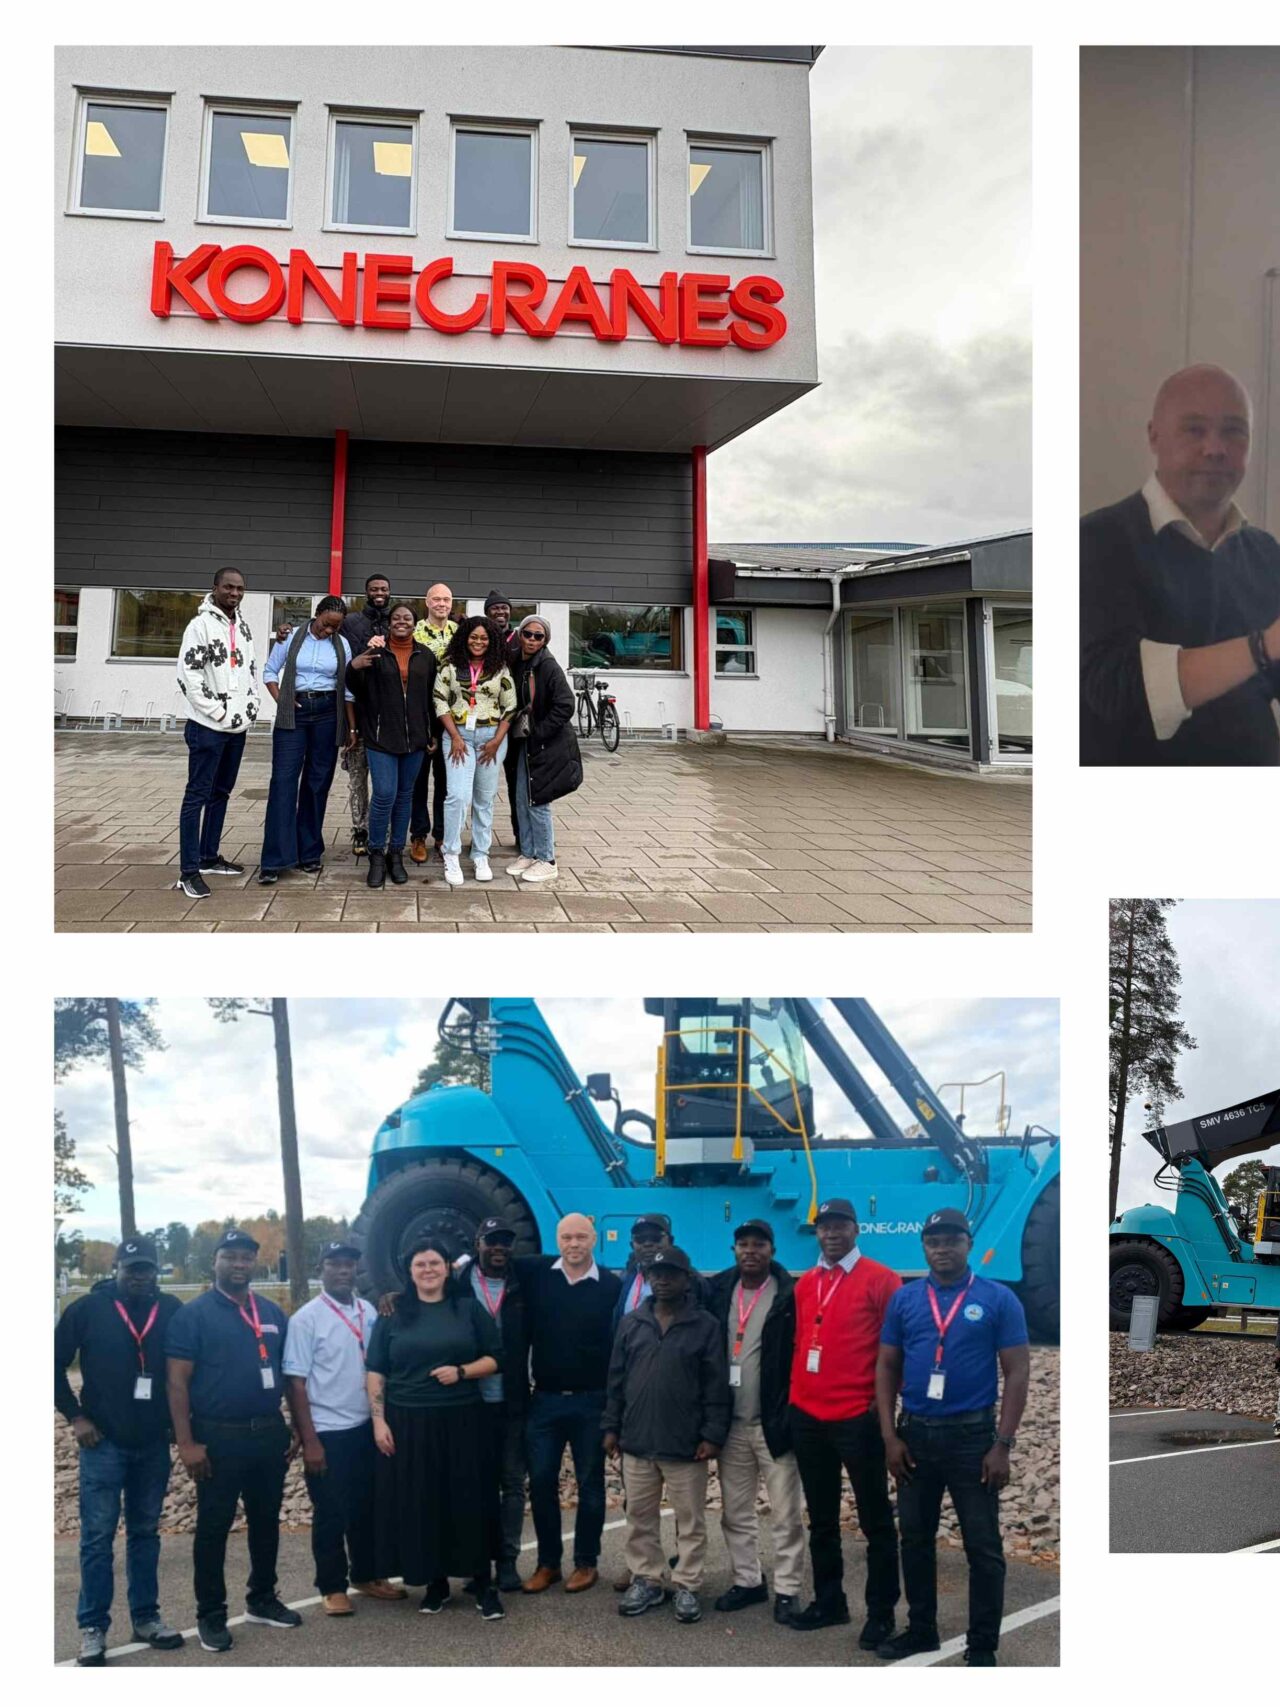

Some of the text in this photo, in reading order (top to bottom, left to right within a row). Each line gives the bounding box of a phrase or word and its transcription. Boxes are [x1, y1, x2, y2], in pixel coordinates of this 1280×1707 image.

[151, 241, 788, 351] KONECRANES
[1199, 1102, 1266, 1129] SMV 4636 TC5
[857, 1221, 925, 1235] ONECRAN
